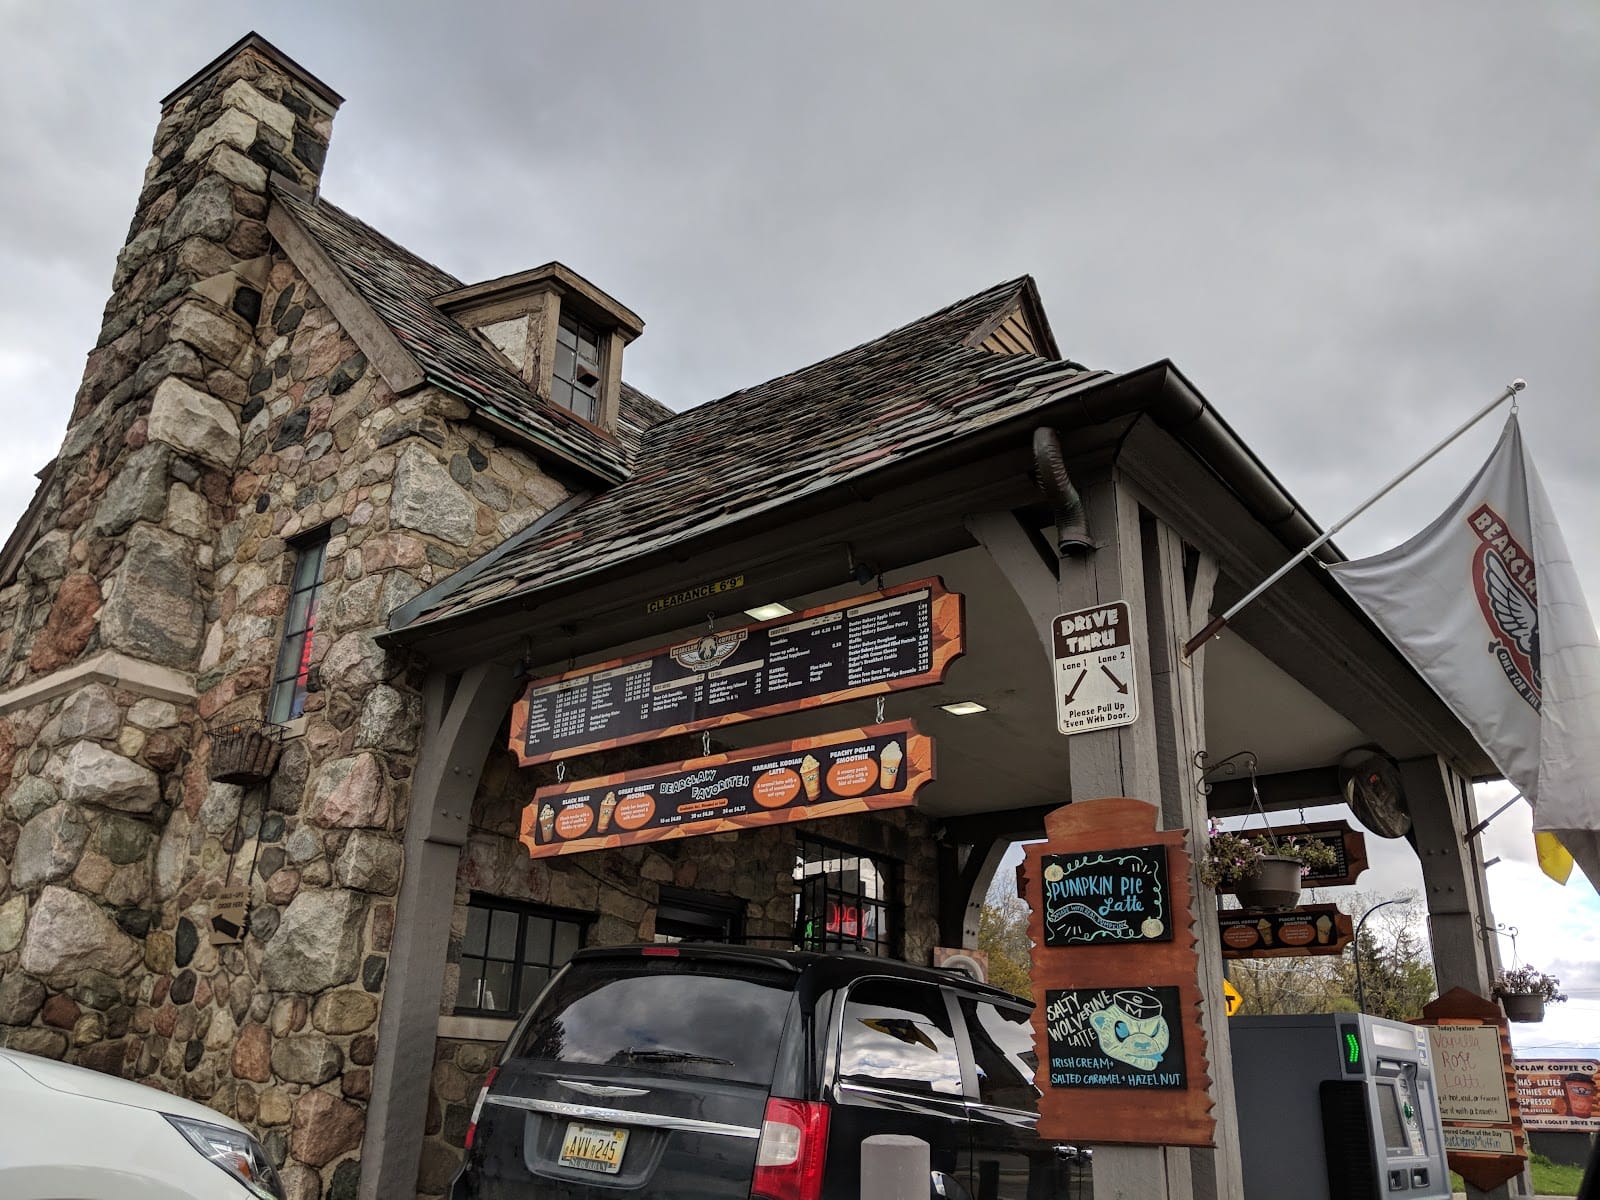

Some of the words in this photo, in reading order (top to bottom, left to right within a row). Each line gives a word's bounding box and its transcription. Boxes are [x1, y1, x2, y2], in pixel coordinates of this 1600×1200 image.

[1473, 511, 1537, 598] BEARCLA
[650, 585, 715, 612] CLEARANCE
[1061, 608, 1119, 636] DRIVE
[1066, 628, 1116, 654] THRU
[1062, 661, 1081, 671] Lane
[1098, 655, 1117, 664] Lane
[1120, 651, 1126, 659] 2
[1500, 652, 1514, 672] ONE
[1510, 673, 1527, 691] FOR
[1069, 708, 1095, 718] Please
[1097, 704, 1112, 713] Pull
[1115, 702, 1125, 712] Up
[1066, 718, 1084, 728] Even
[1087, 714, 1105, 724] With
[830, 749, 853, 758] PEACHY
[854, 745, 876, 754] POLAR
[836, 753, 869, 764] SMOOTHIE
[752, 762, 779, 772] KARAMEL
[660, 769, 717, 794] BEARCLAW
[691, 775, 750, 800] FAVORITES
[562, 797, 577, 805] BLACK
[626, 792, 645, 800] MOCHA
[1051, 875, 1113, 901] PUMPKIN
[1071, 905, 1084, 913] WITH
[1099, 895, 1144, 916] Latte
[1047, 992, 1081, 1021] SALTY
[1048, 990, 1113, 1041] WOLVERINE
[1068, 1028, 1097, 1047] LATTE
[1052, 1057, 1075, 1068] IRISH
[1051, 1073, 1082, 1085] SALTED
[1083, 1073, 1121, 1085] CARAMEL
